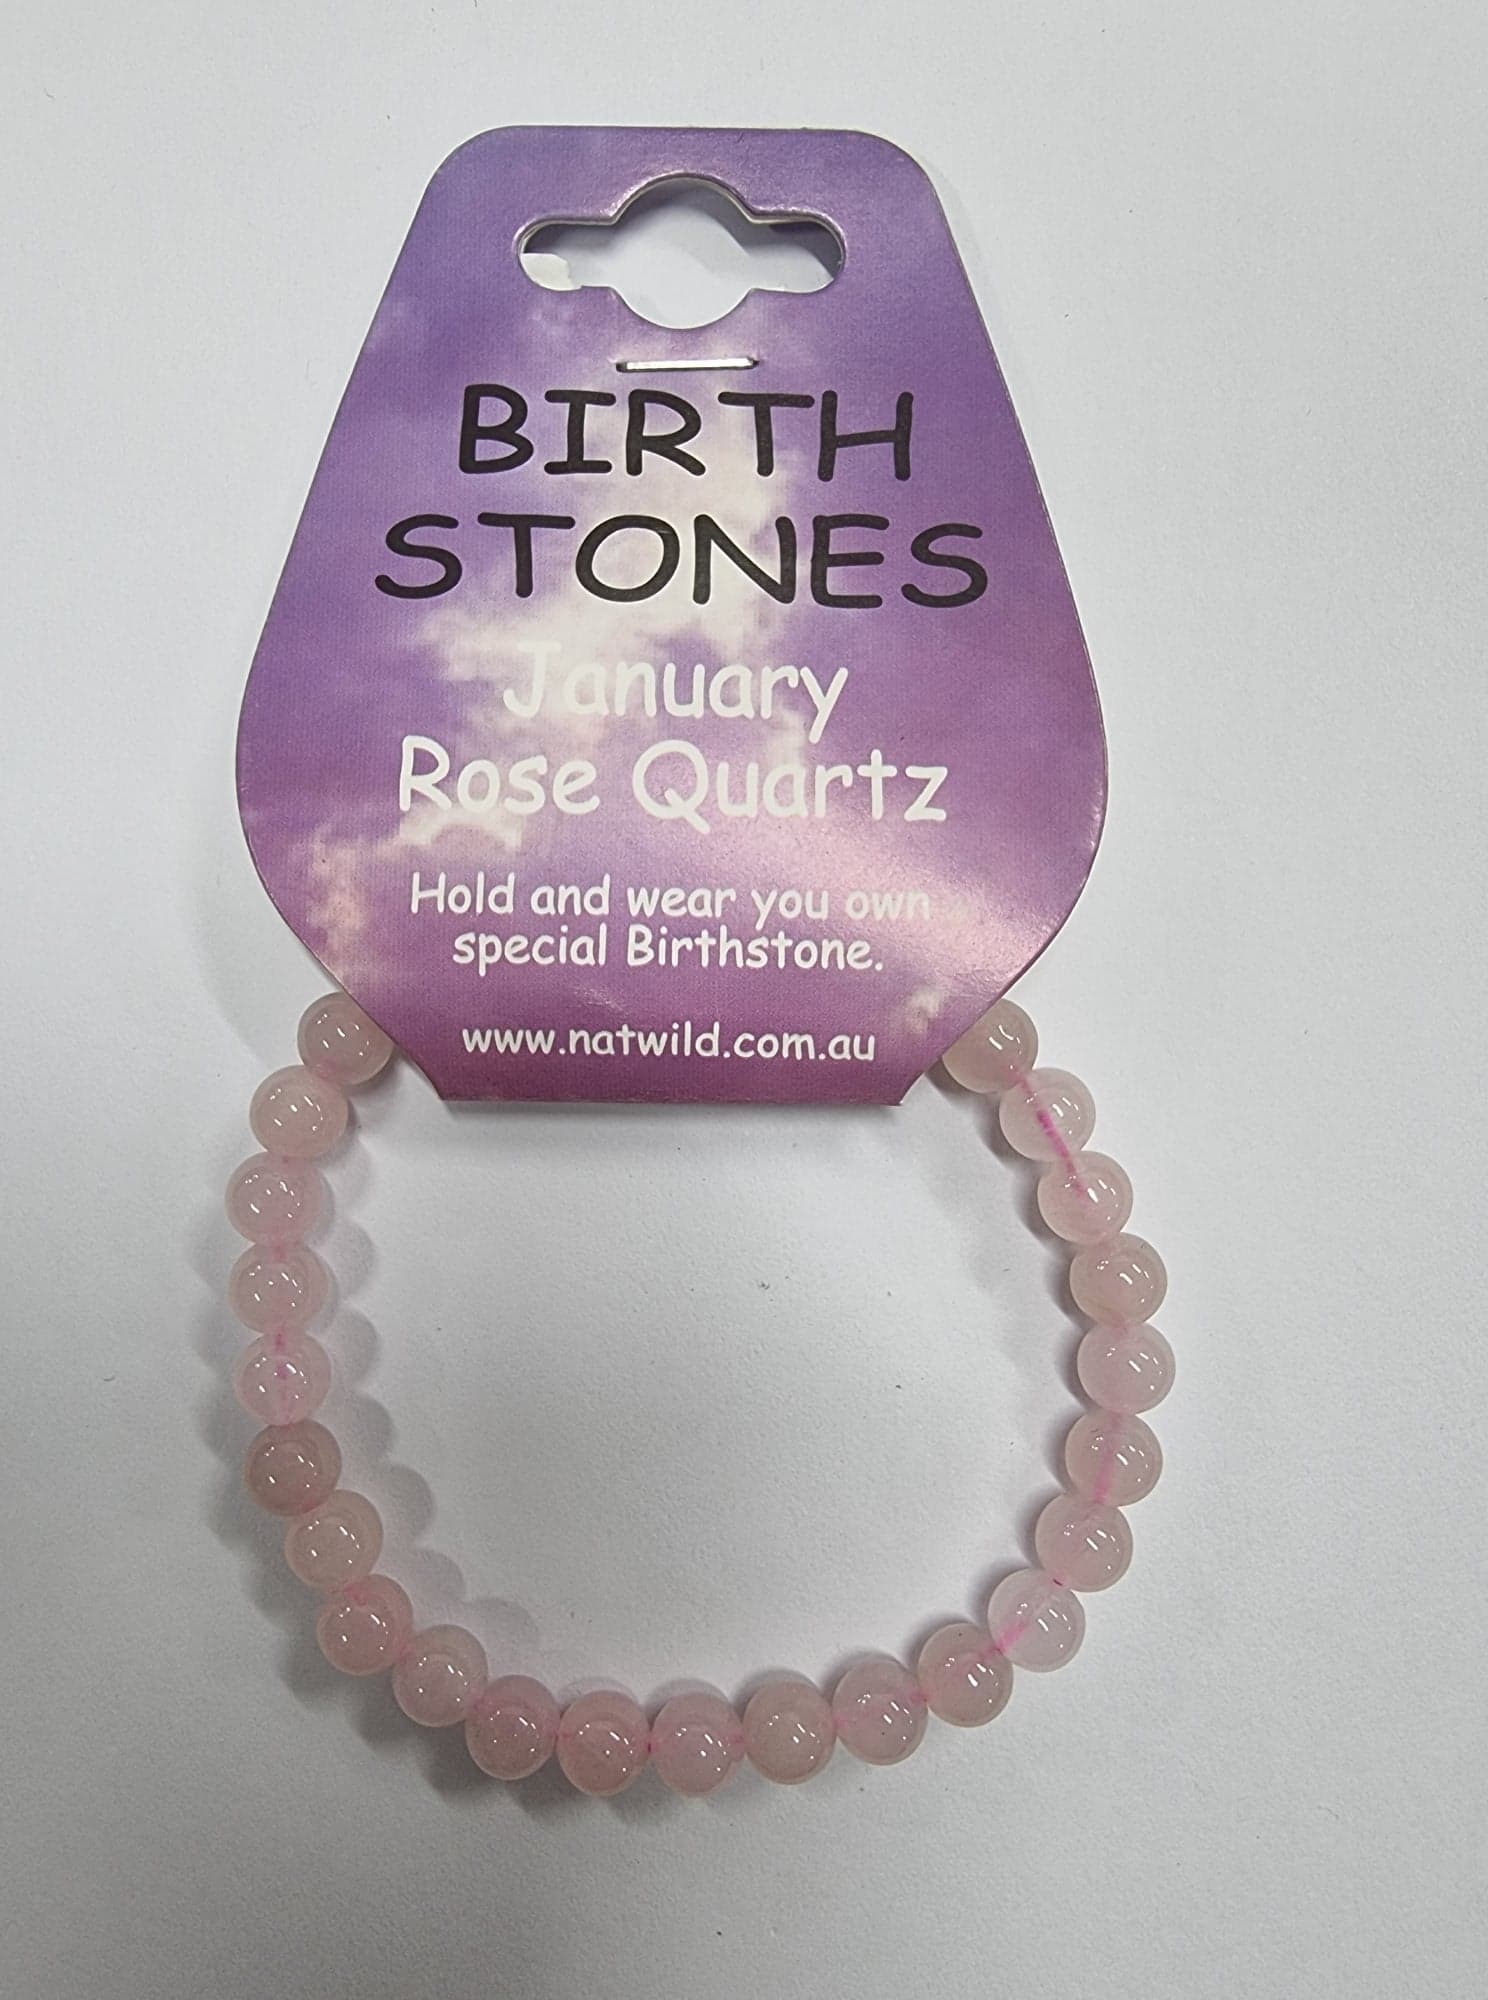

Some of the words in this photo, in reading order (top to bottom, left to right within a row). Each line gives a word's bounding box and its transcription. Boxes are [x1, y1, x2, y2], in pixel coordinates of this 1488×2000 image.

[458, 384, 914, 481] BIRTH
[375, 512, 988, 608] STONES
[503, 641, 849, 743] January
[399, 735, 600, 813] Rose
[632, 739, 948, 834] Quartz
[410, 872, 516, 915] Hold
[530, 873, 611, 916] and
[626, 886, 737, 918] wear
[752, 889, 830, 930] you
[845, 890, 931, 920] own
[452, 923, 608, 976] special
[626, 924, 884, 971] Birthstone.
[462, 1021, 876, 1061] www.natwild.com.au
